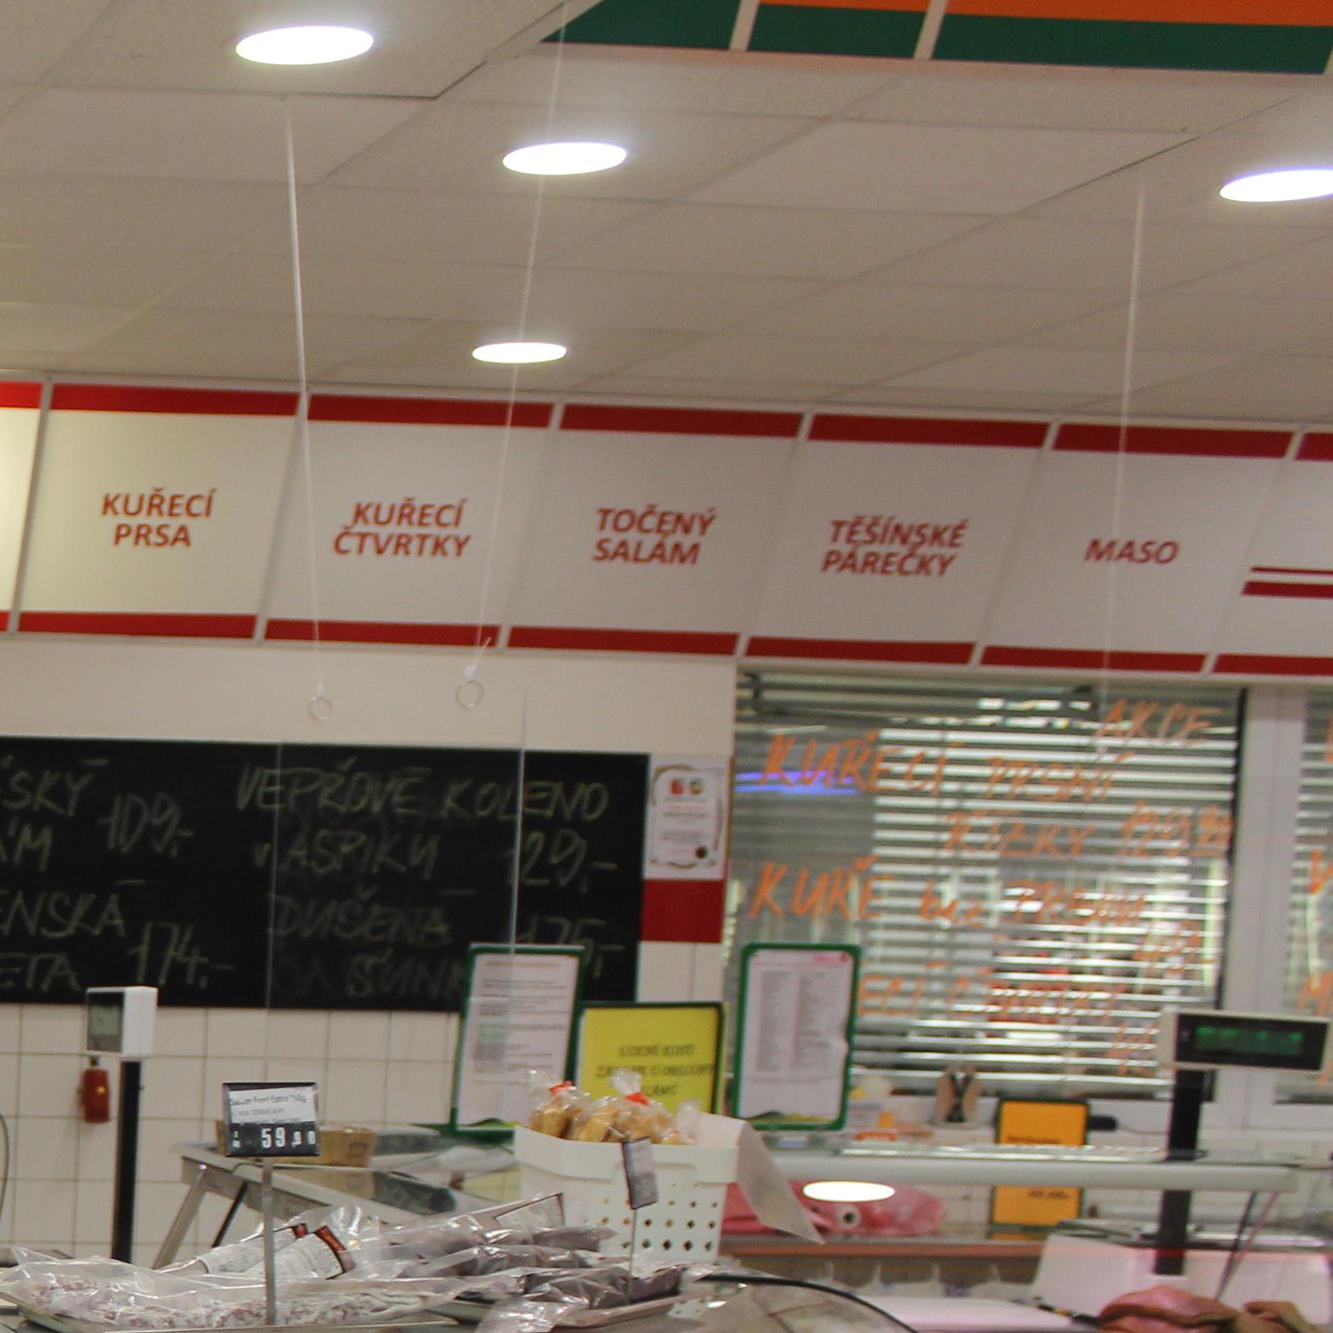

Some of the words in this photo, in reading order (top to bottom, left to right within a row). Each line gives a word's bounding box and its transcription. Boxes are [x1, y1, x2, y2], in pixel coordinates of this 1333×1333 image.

[102, 488, 218, 518] KUŘECÍ
[352, 498, 467, 529] KUŘECÍ
[114, 524, 192, 548] PRSA
[597, 504, 717, 538] TOČENÝ
[830, 513, 970, 549] TĚŠÍNSKÉ
[333, 525, 471, 558] ČTVRTKY
[592, 534, 700, 566] SALÁM
[1085, 539, 1179, 566] MASO
[823, 546, 957, 577] PÁREČKY
[440, 778, 610, 822] KOLENO
